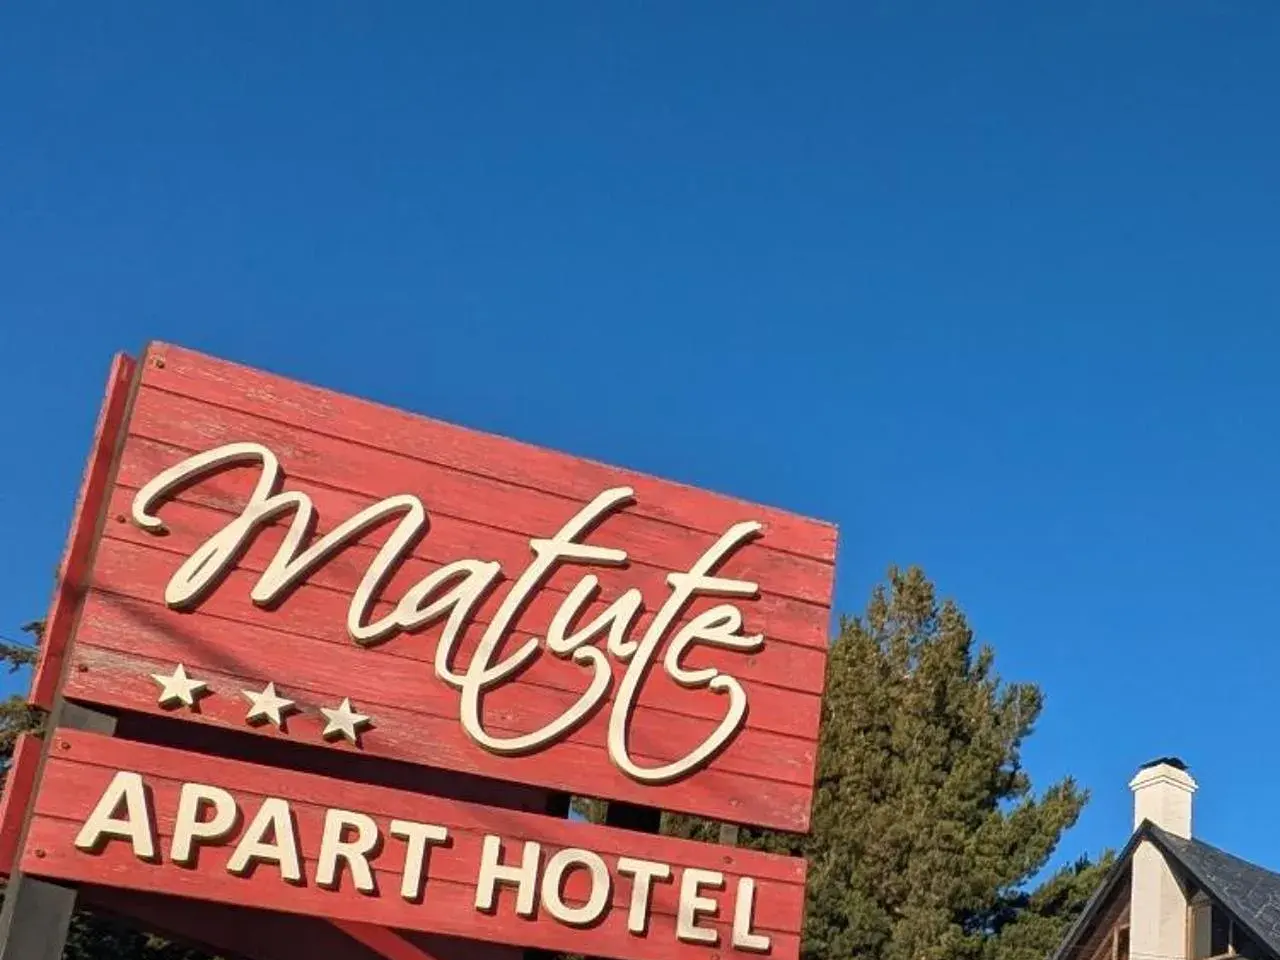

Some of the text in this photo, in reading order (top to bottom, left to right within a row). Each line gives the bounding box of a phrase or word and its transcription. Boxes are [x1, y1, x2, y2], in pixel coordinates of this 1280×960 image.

[132, 441, 765, 784] Matute
[74, 770, 771, 953] APART HOTEL
